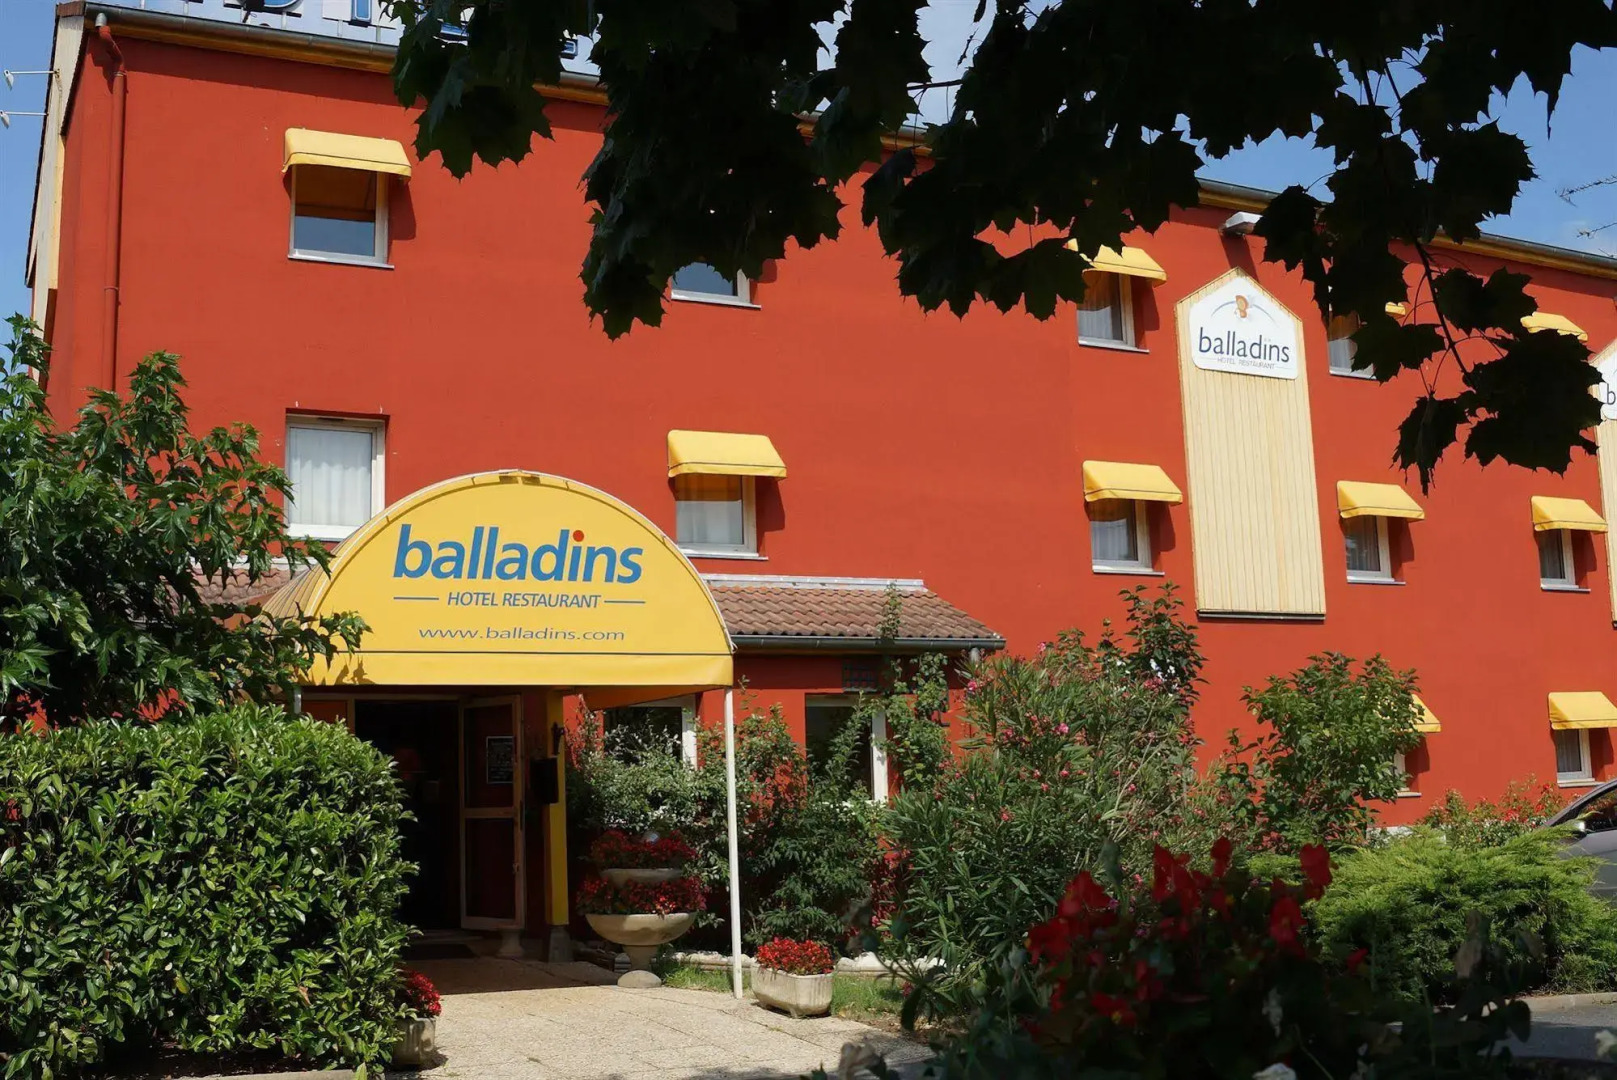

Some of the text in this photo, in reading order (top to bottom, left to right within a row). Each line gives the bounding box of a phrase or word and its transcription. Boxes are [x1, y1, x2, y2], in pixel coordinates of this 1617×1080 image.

[1217, 357, 1236, 366] HOTEL
[393, 524, 643, 584] balladins
[447, 592, 602, 608] HOTEL RESTAURANT
[418, 627, 625, 641] www.balladins.com
